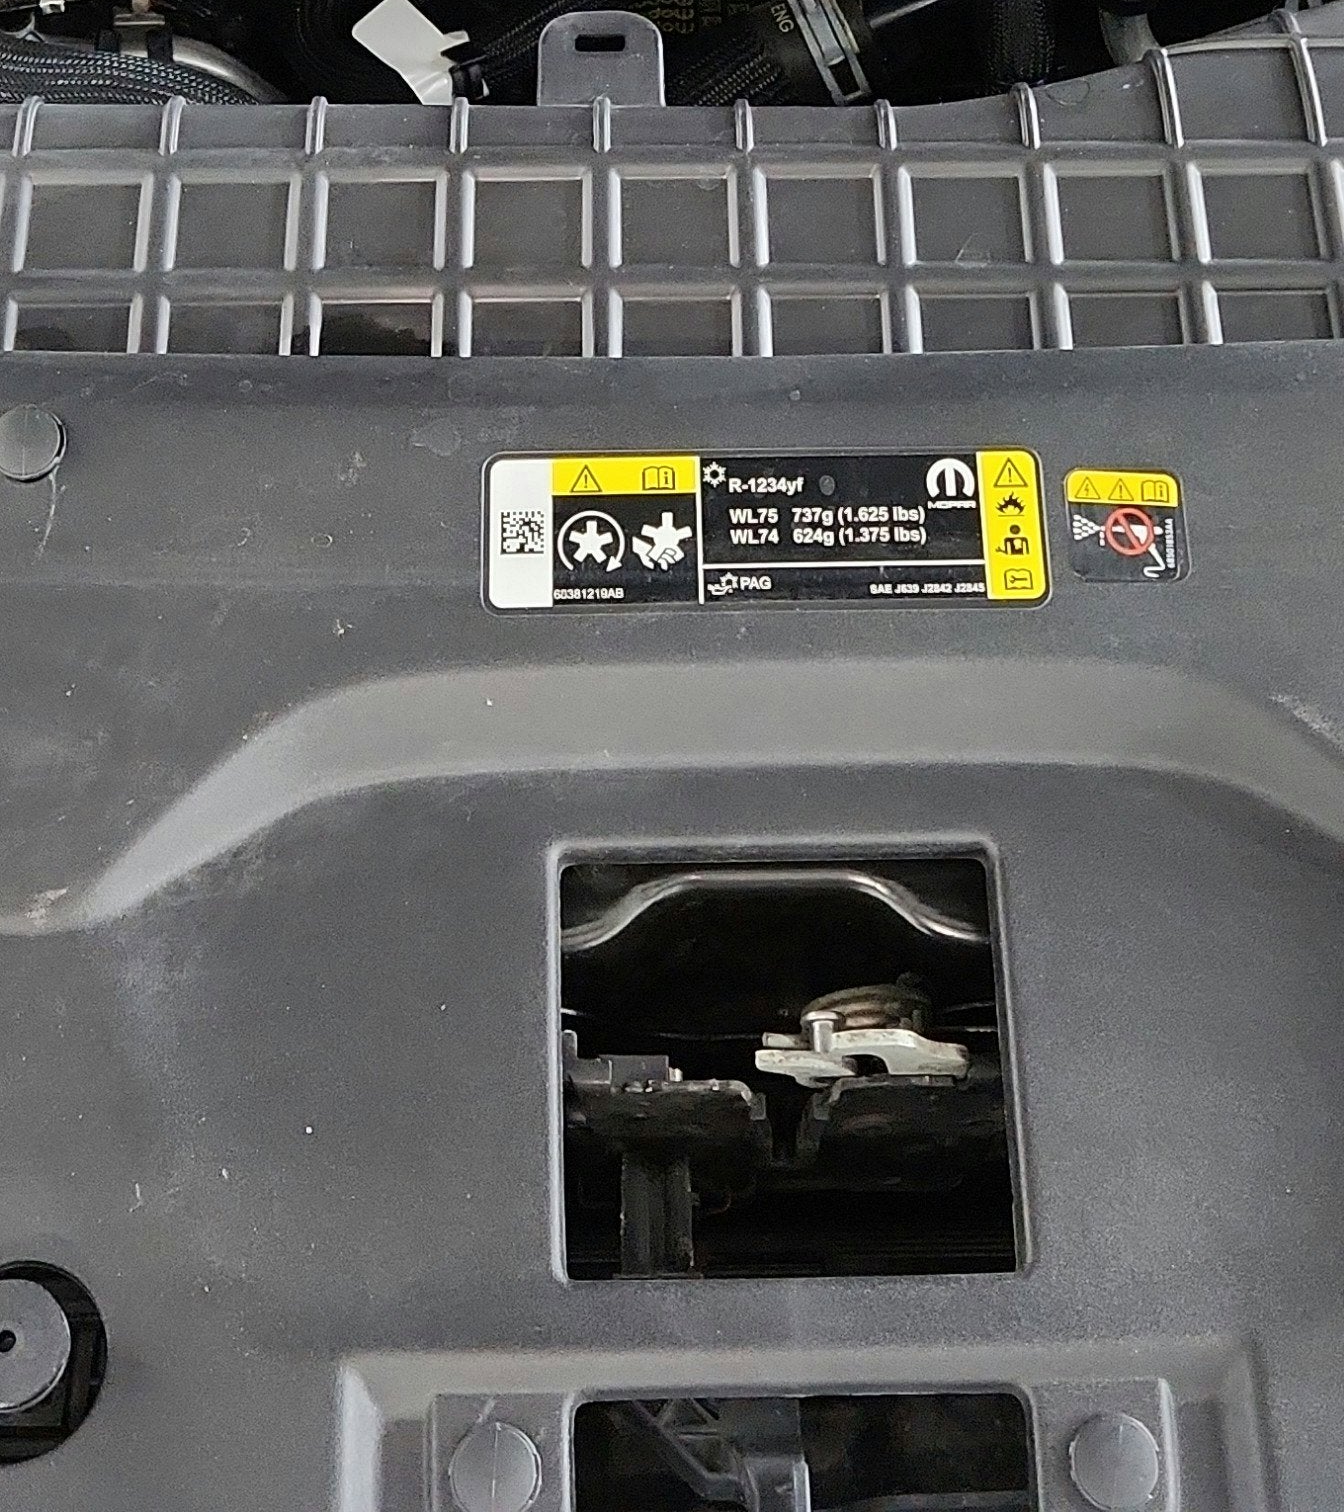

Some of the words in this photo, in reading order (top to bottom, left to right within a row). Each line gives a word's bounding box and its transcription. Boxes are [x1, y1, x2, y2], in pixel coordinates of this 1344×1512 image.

[771, 3, 794, 33] ENG
[728, 477, 804, 496] R-1234yf
[927, 500, 976, 509] MOPAR
[729, 508, 778, 524] WL75
[791, 507, 834, 526] 737g
[837, 506, 889, 525] (1.625
[892, 506, 926, 525] lbs)
[729, 529, 779, 544] WL74
[792, 528, 835, 546] 624g
[838, 527, 891, 546] (1.375
[894, 526, 927, 545] lbs)
[739, 575, 772, 590] PAG
[869, 583, 893, 594] SAE
